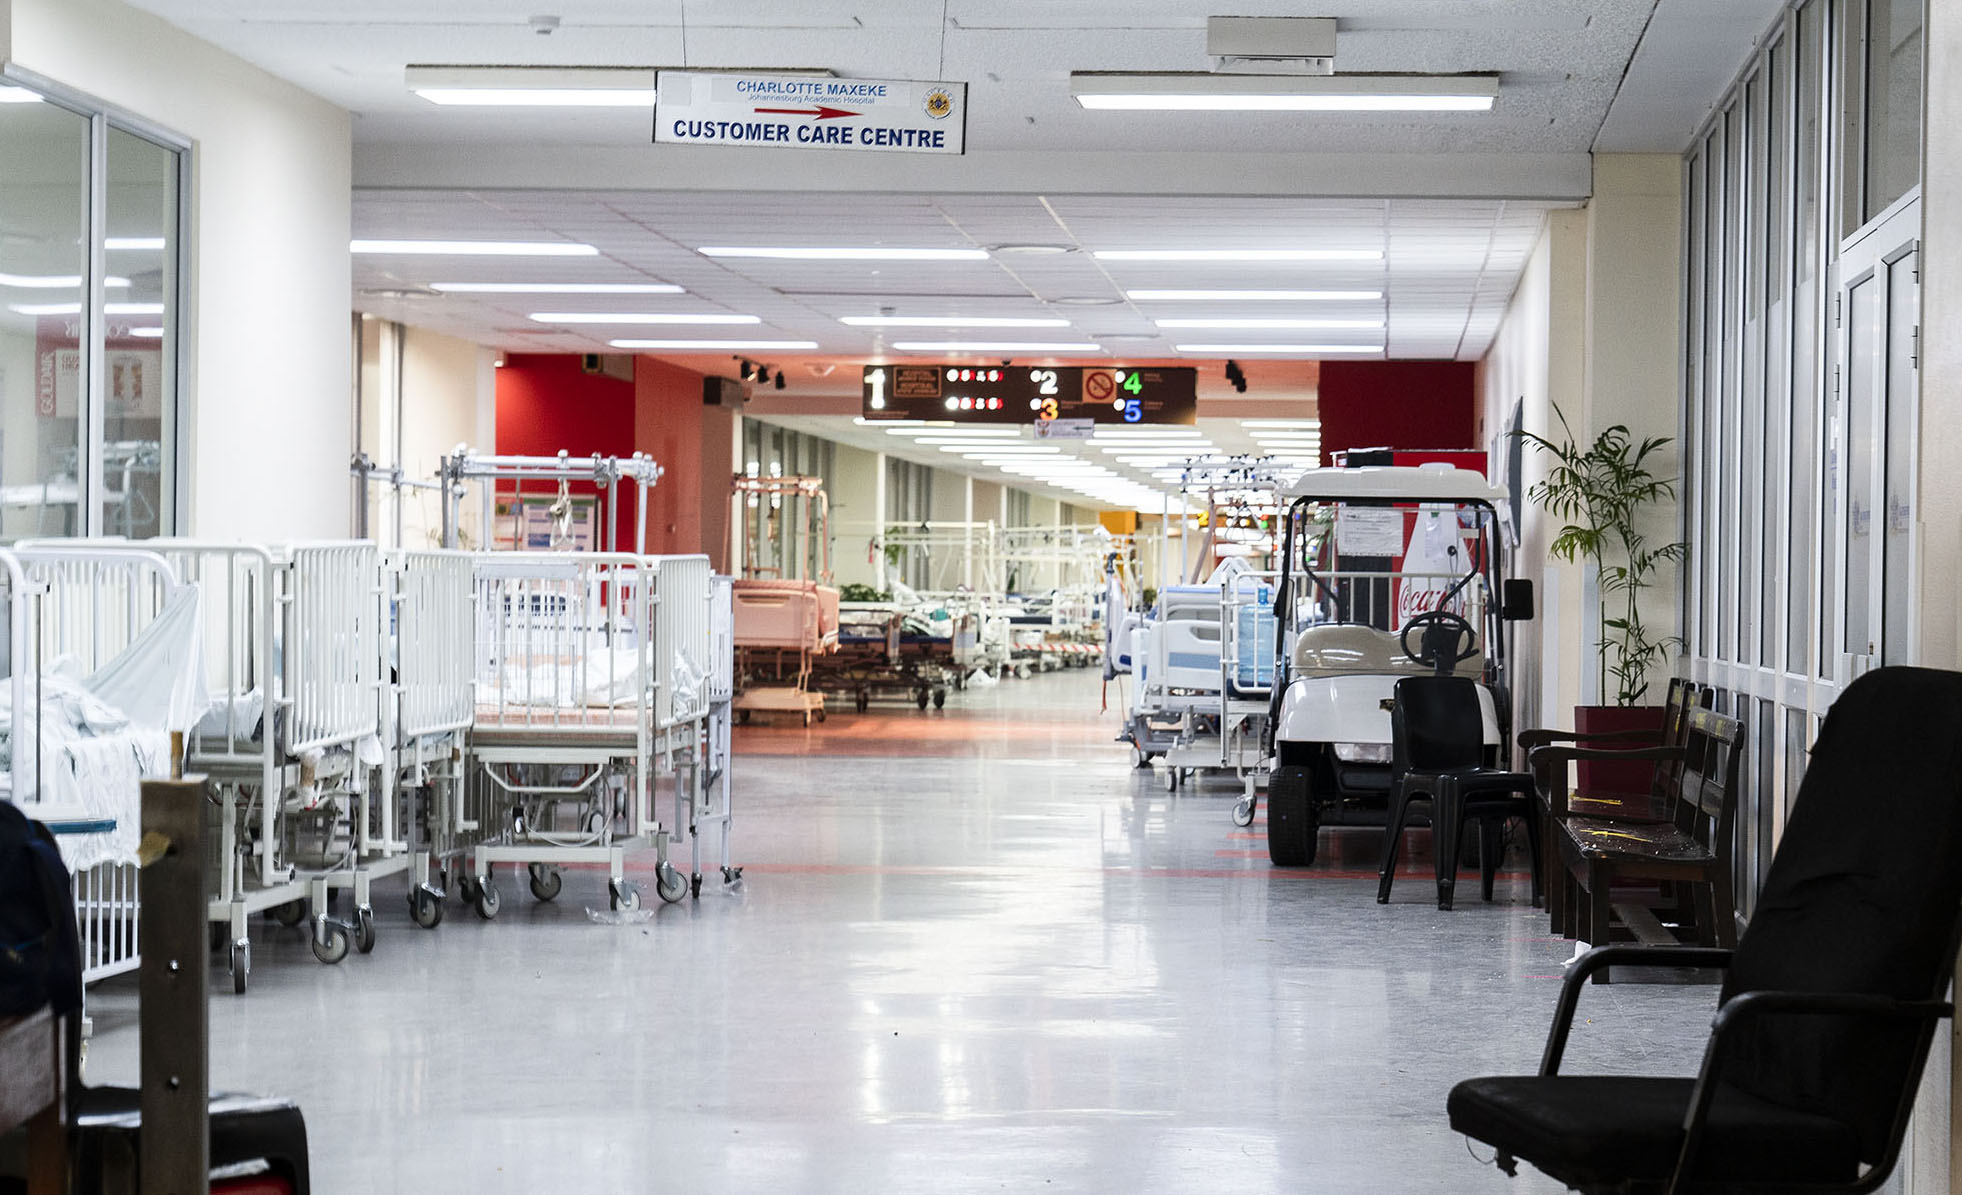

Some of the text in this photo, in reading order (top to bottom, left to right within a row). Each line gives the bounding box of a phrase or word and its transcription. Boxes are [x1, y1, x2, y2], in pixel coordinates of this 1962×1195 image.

[737, 80, 887, 97] CHARLOTTE MAXEKE
[748, 93, 875, 105] Johannesburg Academic Hospital
[673, 120, 944, 148] CUSTOMER CARE CENTRE
[864, 368, 886, 409] 1
[1039, 370, 1059, 395] 2
[1123, 371, 1143, 395] 4
[1039, 397, 1059, 420] 3
[1123, 399, 1143, 423] 5
